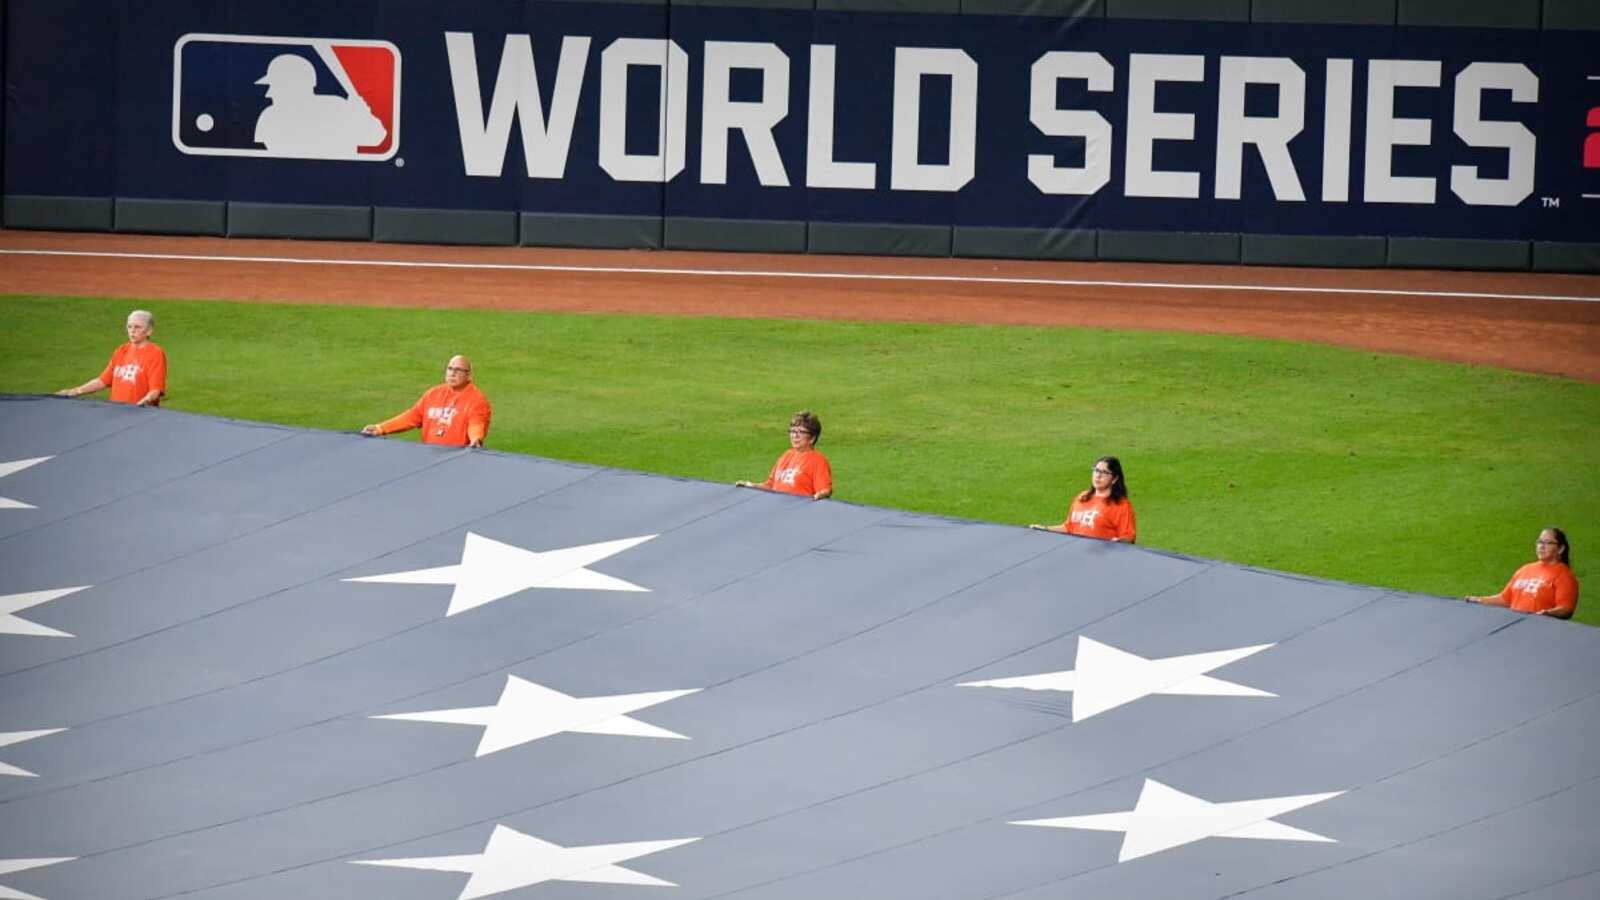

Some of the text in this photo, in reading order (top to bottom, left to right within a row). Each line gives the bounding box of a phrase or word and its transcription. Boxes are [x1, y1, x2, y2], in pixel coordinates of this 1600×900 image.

[444, 31, 1539, 206] WORLD SERIES
[1541, 197, 1560, 207] TM
